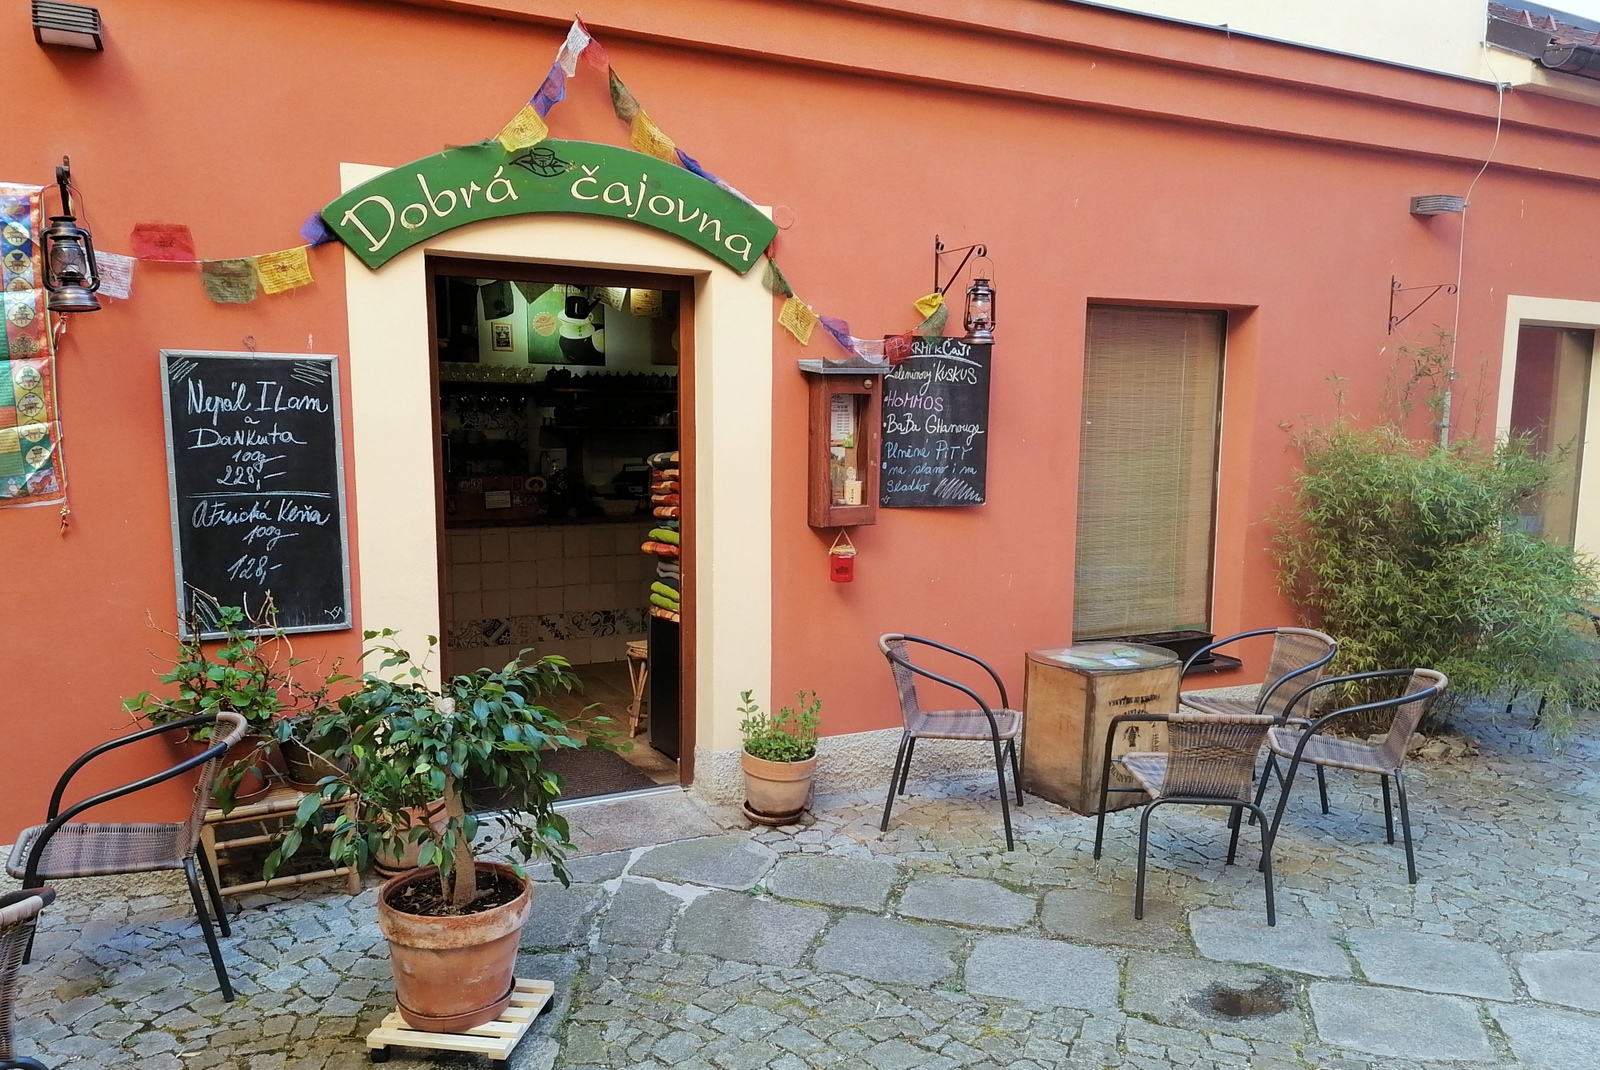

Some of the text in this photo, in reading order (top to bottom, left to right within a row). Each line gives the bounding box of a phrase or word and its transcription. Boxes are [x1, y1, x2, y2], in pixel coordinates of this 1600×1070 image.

[340, 164, 754, 262] Dobrá čajovna
[244, 415, 260, 425] a
